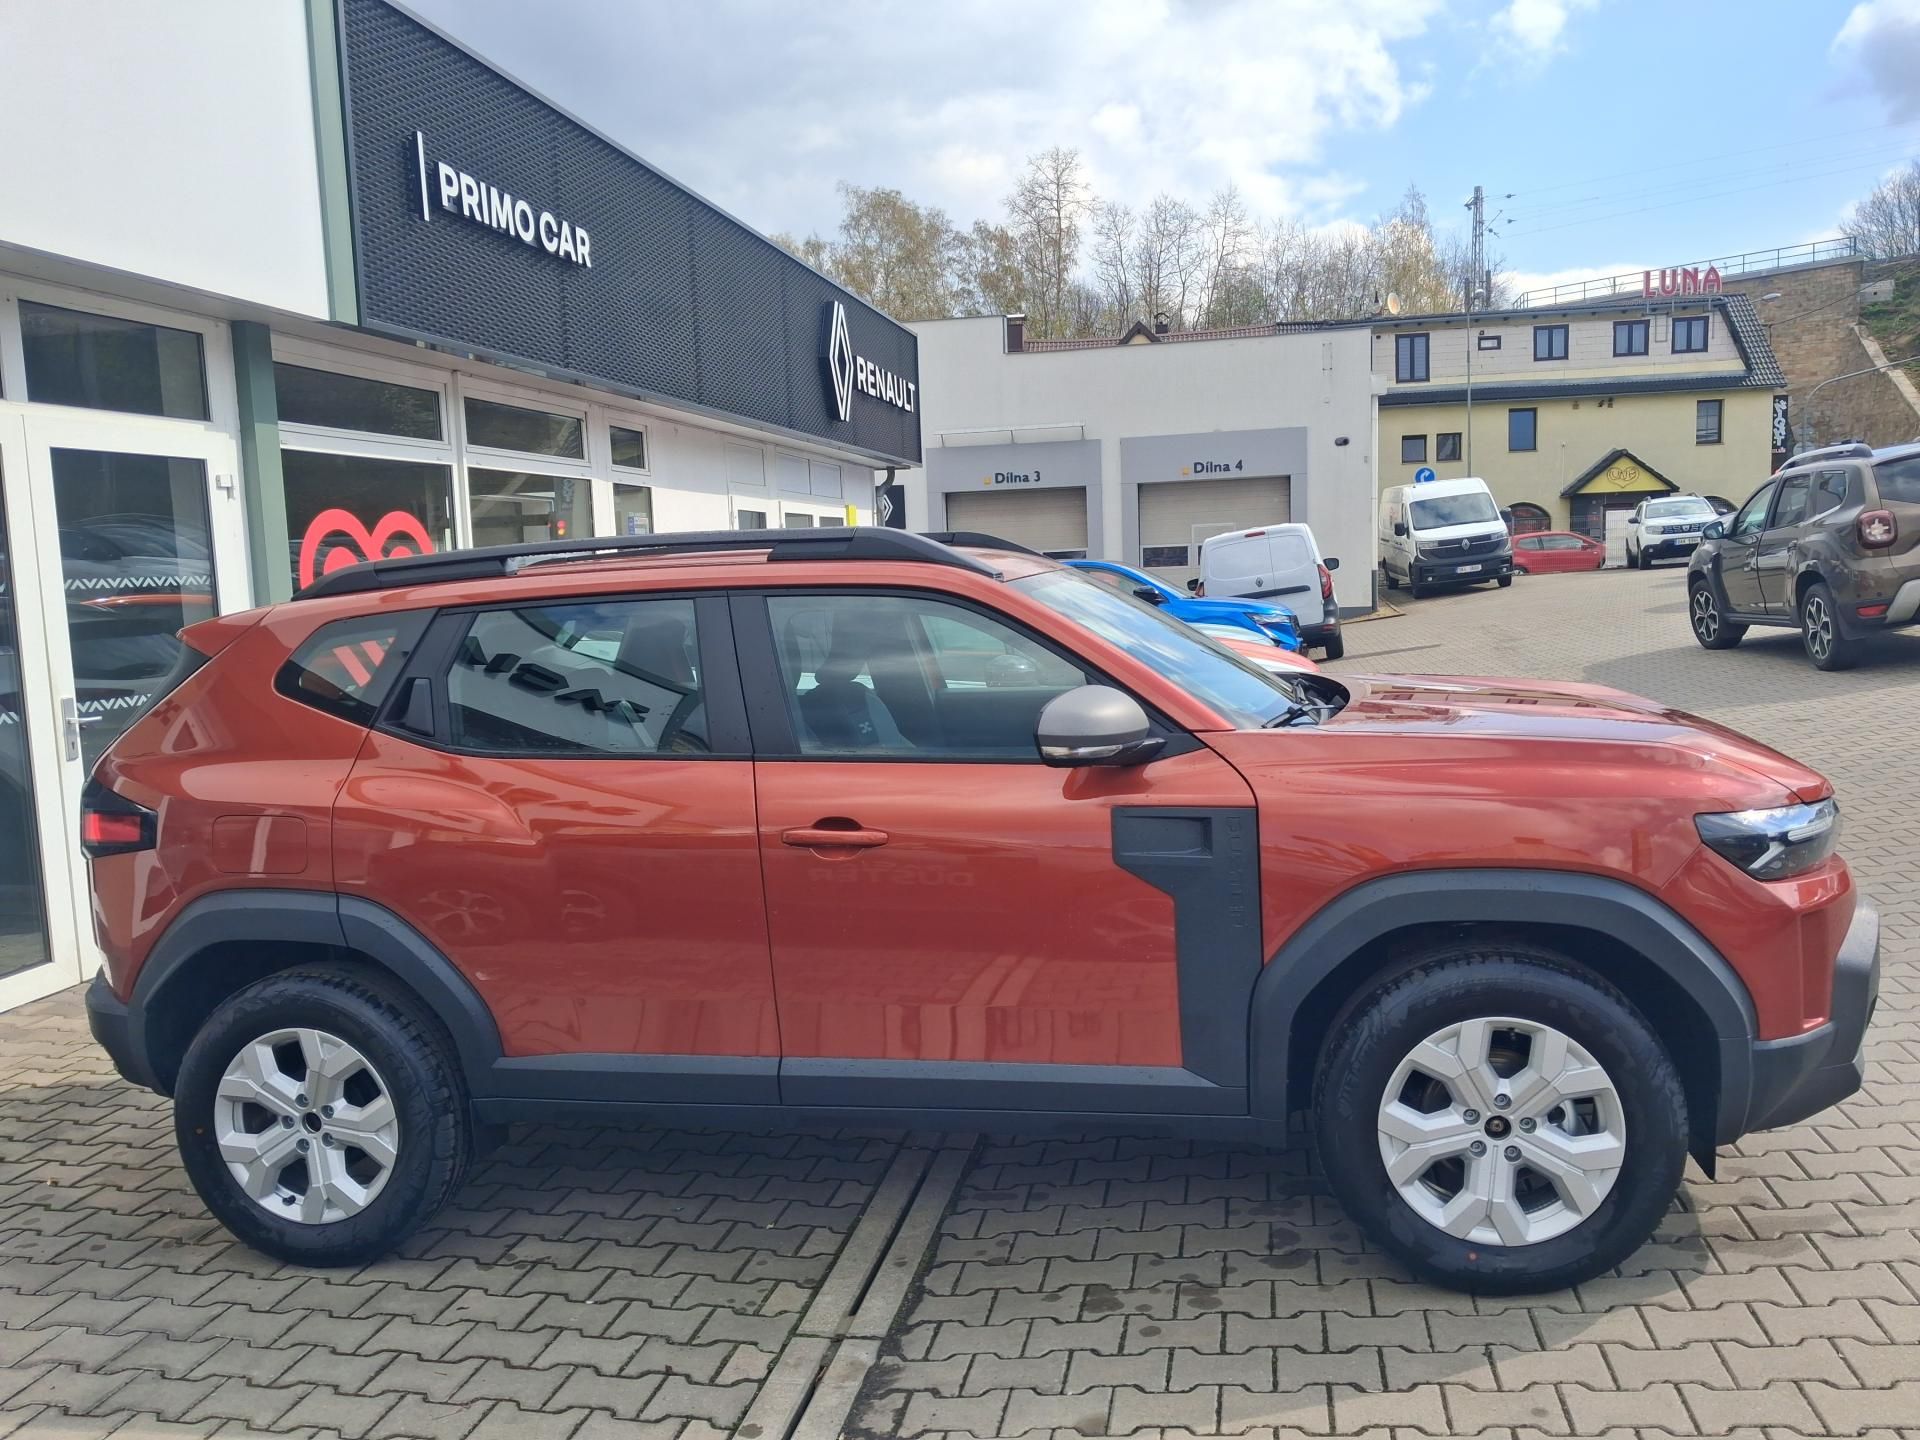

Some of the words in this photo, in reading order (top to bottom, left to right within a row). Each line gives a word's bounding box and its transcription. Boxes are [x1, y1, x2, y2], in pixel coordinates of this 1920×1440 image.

[438, 161, 535, 242] PRIMO
[539, 211, 592, 268] CAR
[1642, 265, 1722, 298] LUNA
[856, 355, 916, 413] RENAULT
[995, 471, 1029, 484] Dílna
[1034, 470, 1041, 482] 3
[1193, 461, 1231, 474] Dílna
[1235, 459, 1243, 471] 4
